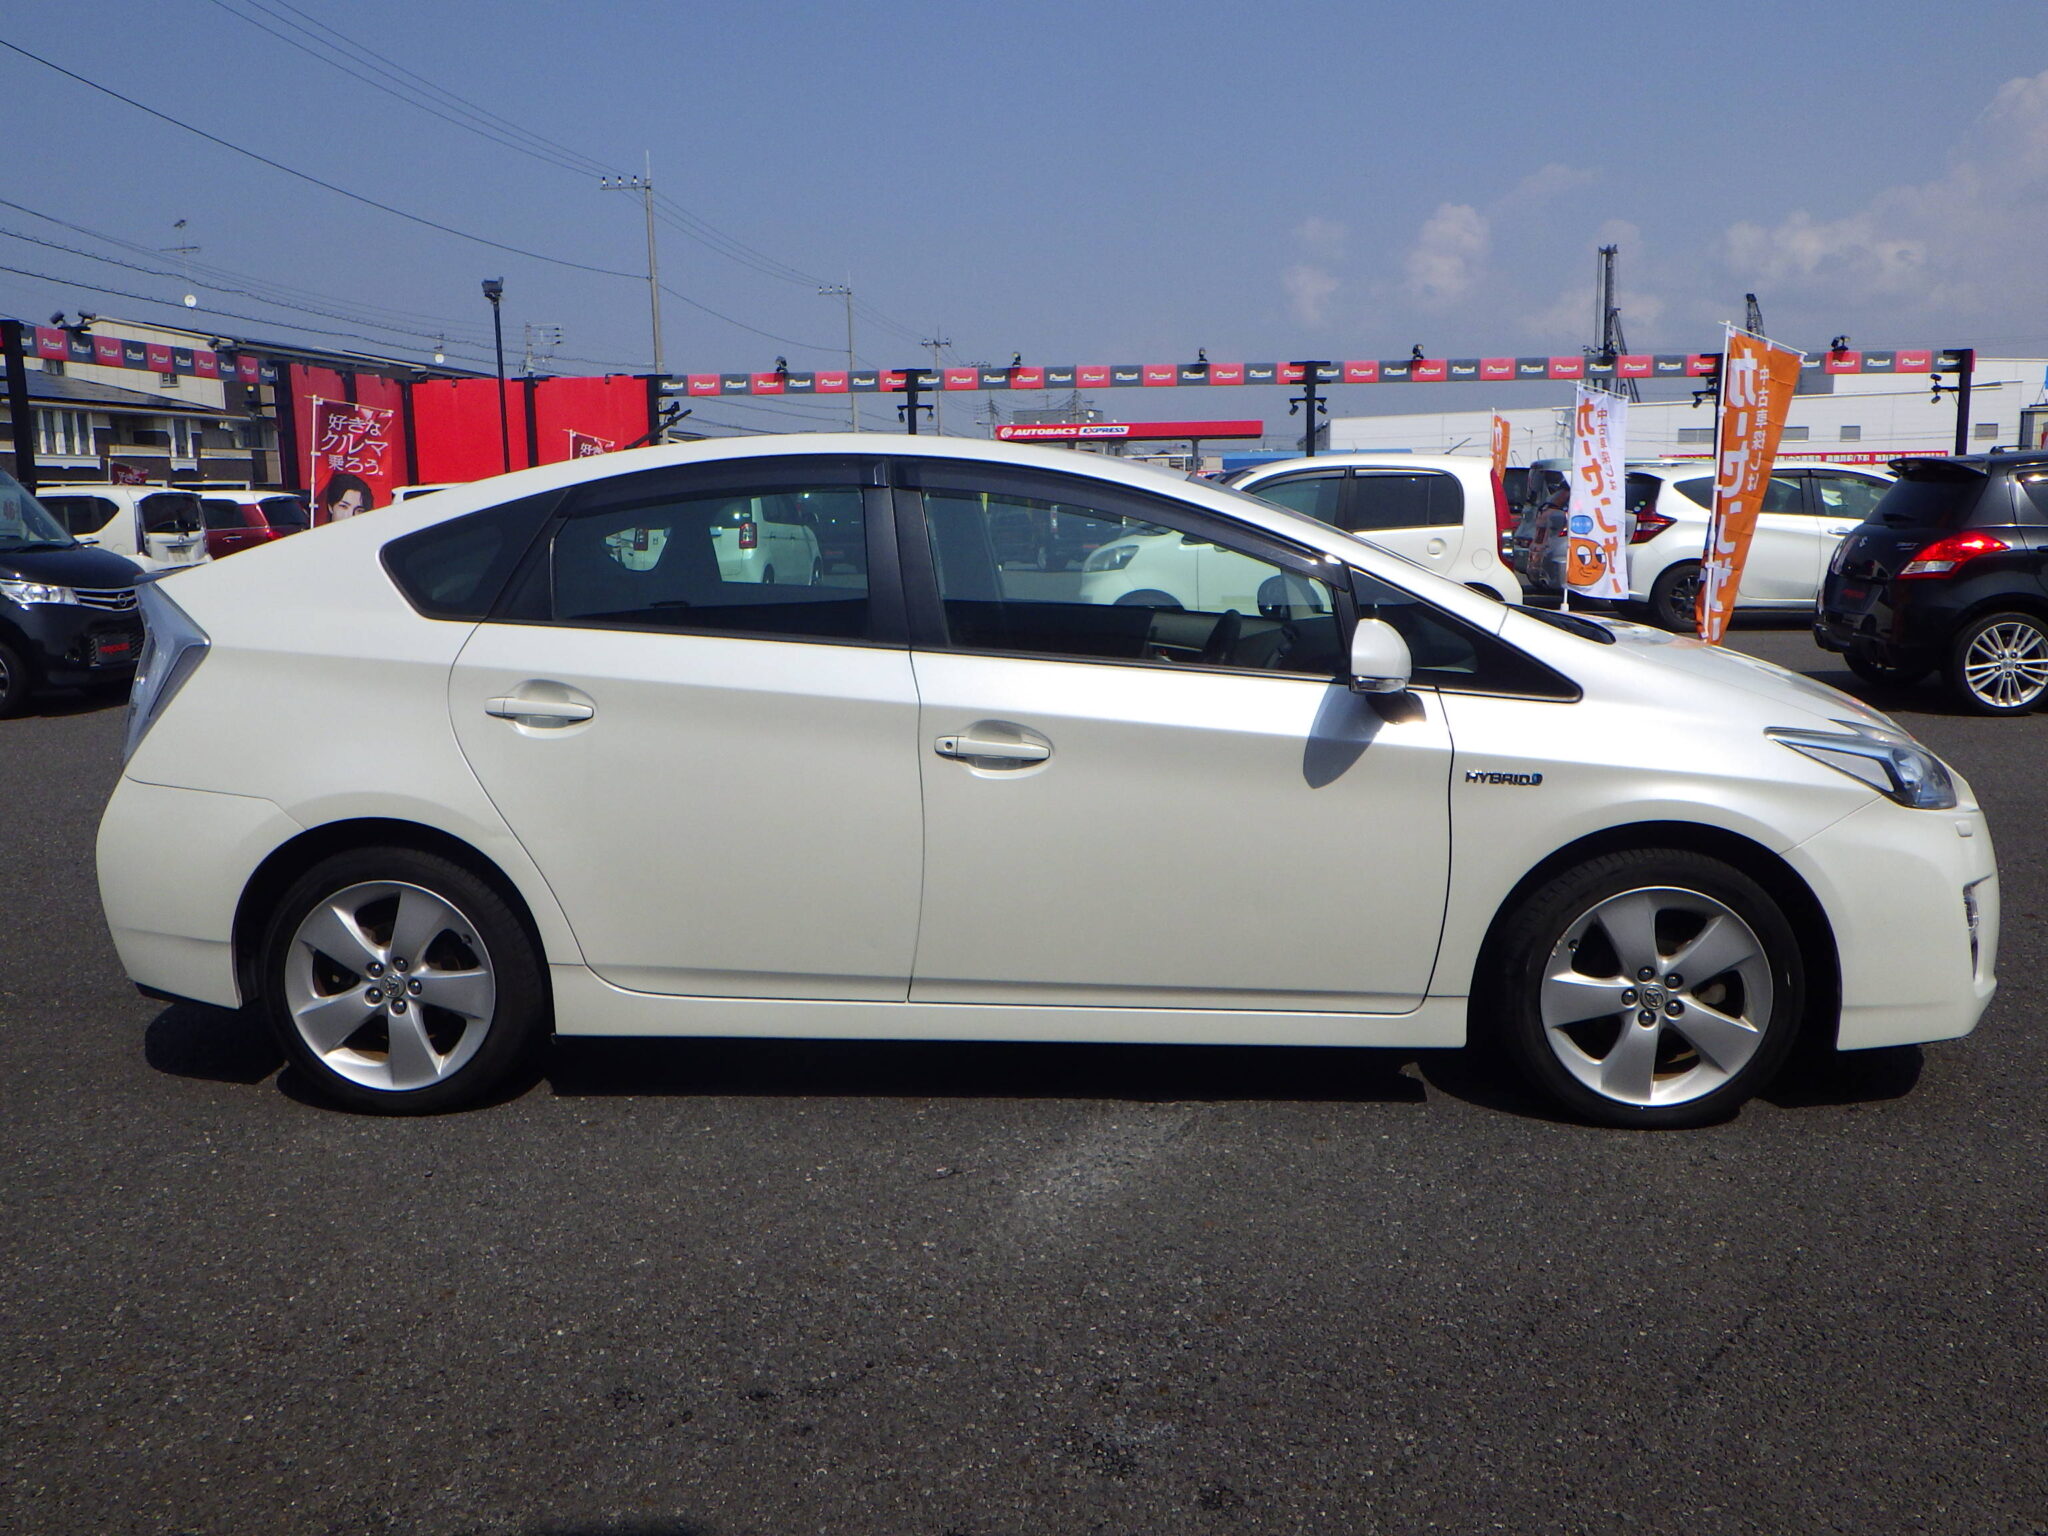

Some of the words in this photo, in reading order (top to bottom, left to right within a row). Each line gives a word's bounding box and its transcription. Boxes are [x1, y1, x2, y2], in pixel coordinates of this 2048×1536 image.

[328, 413, 381, 436] 好きな
[1013, 427, 1077, 436] AUTOBACS
[320, 430, 389, 457] クルマ
[328, 454, 384, 476] 乗ろう。
[1465, 770, 1531, 786] HYBRID
